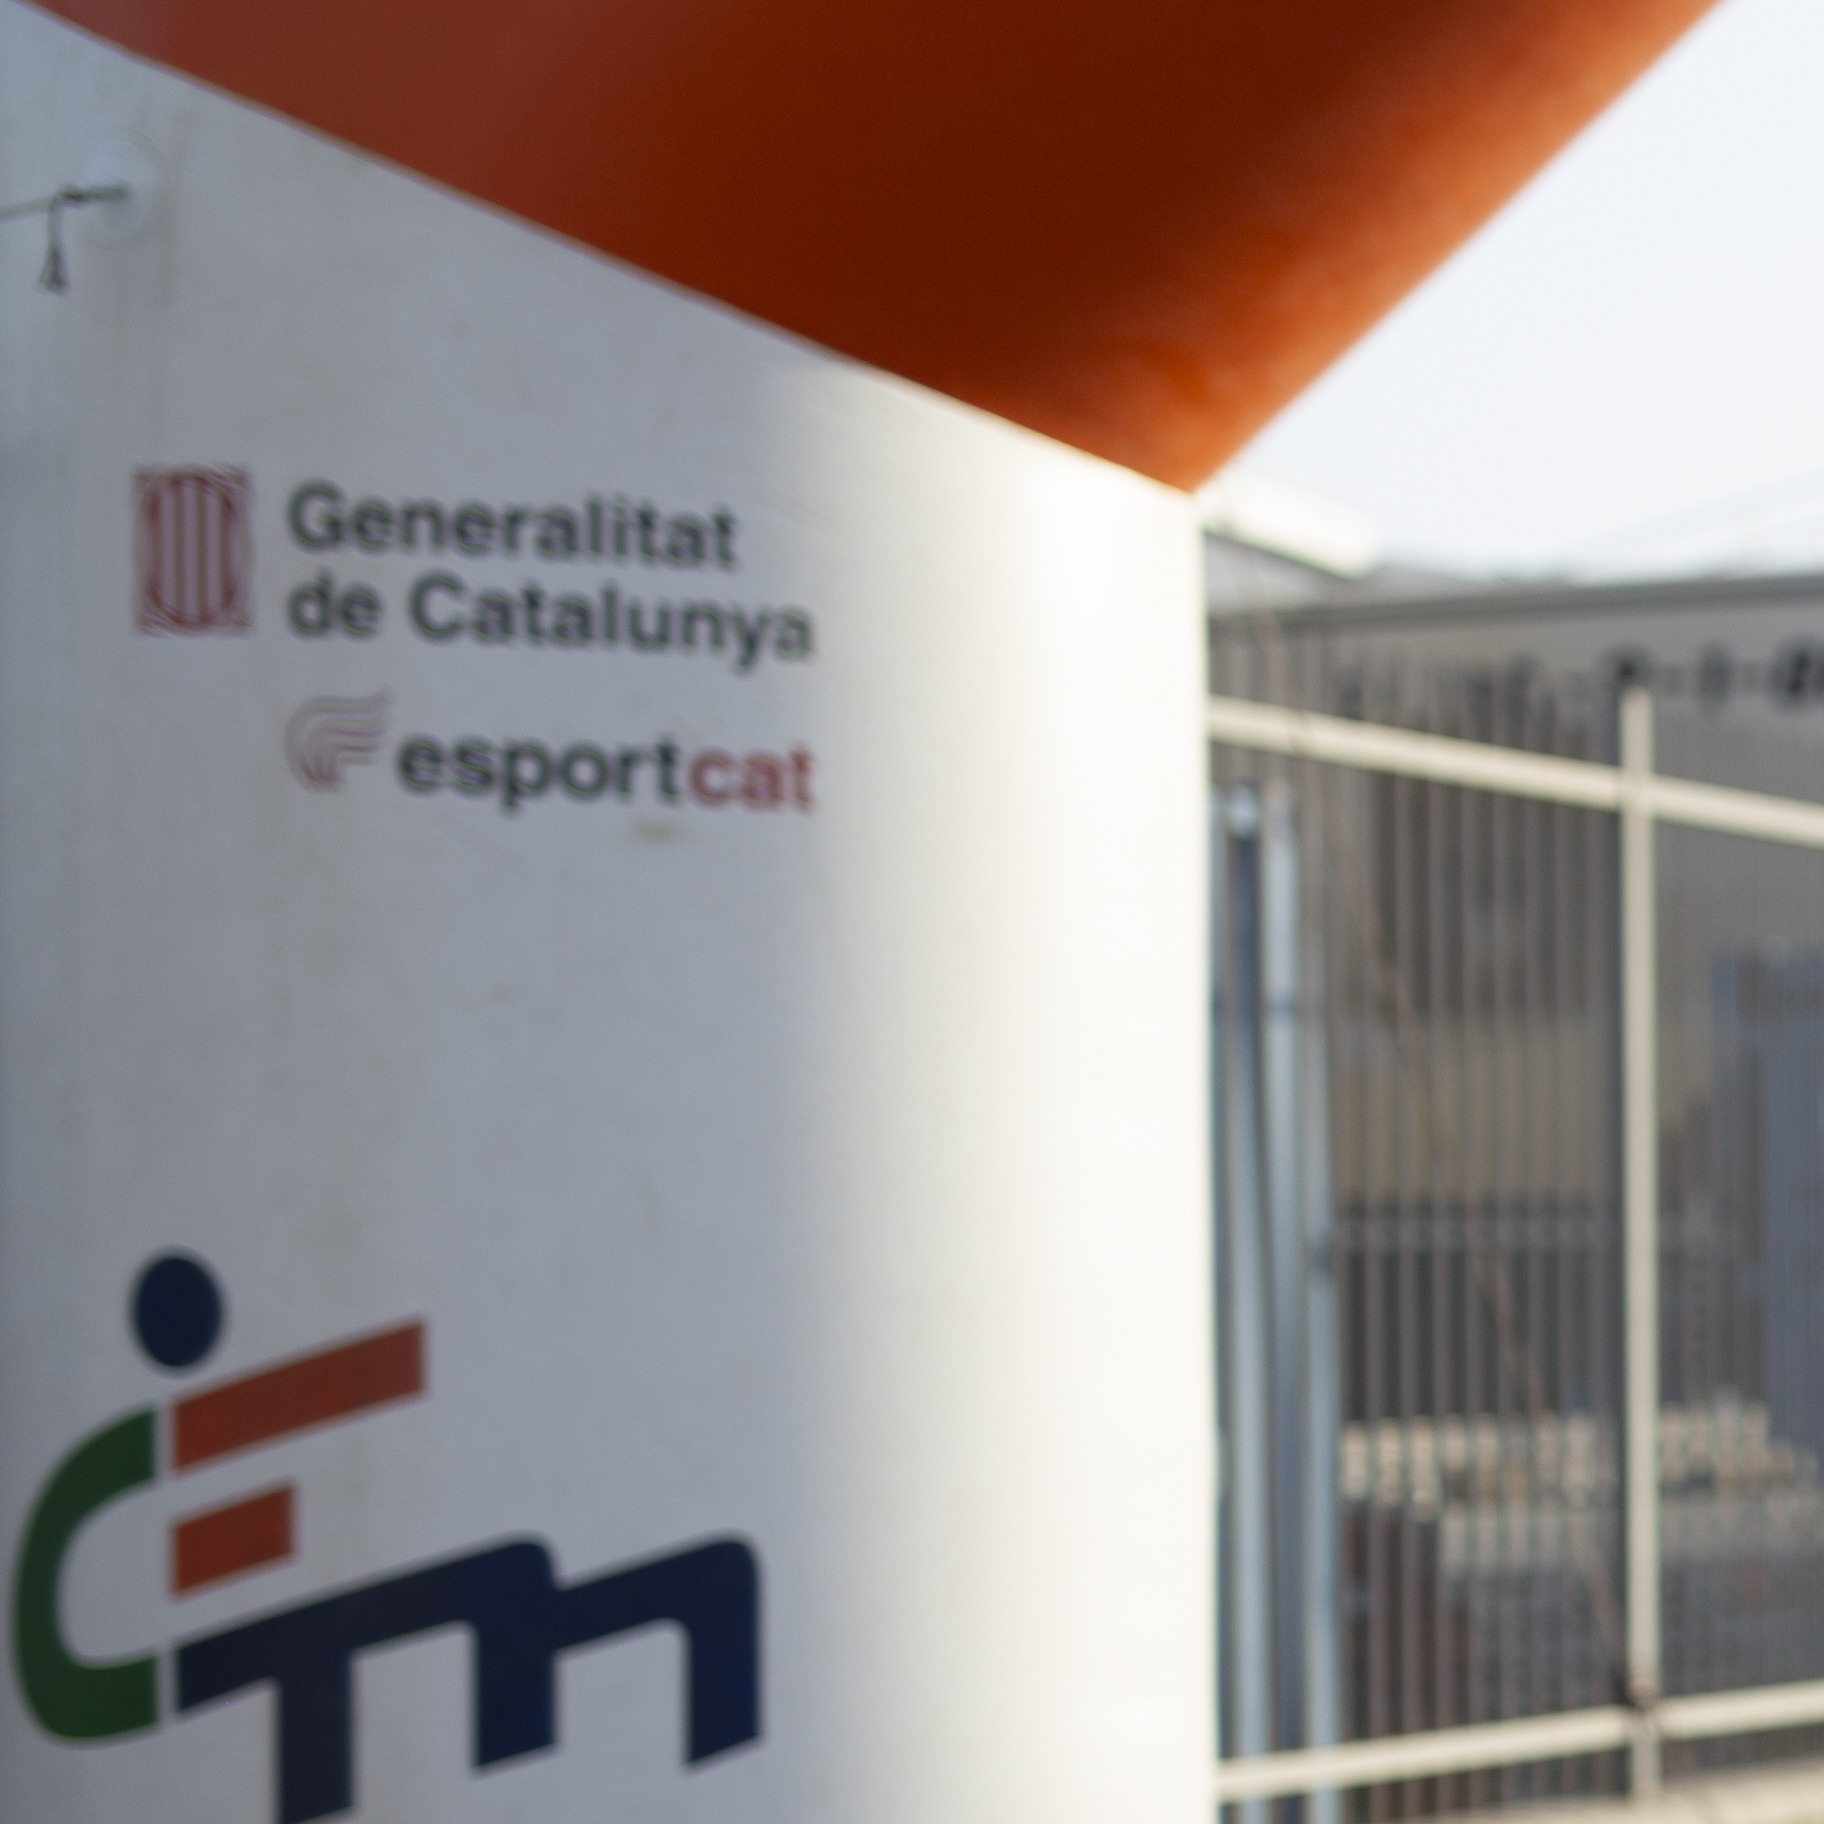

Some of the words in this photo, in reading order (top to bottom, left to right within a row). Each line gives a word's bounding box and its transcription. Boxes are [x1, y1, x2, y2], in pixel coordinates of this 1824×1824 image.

[288, 479, 740, 571] Generalitat
[288, 569, 383, 639] de
[408, 571, 816, 674] Catalunya
[399, 734, 815, 816] esportcat
